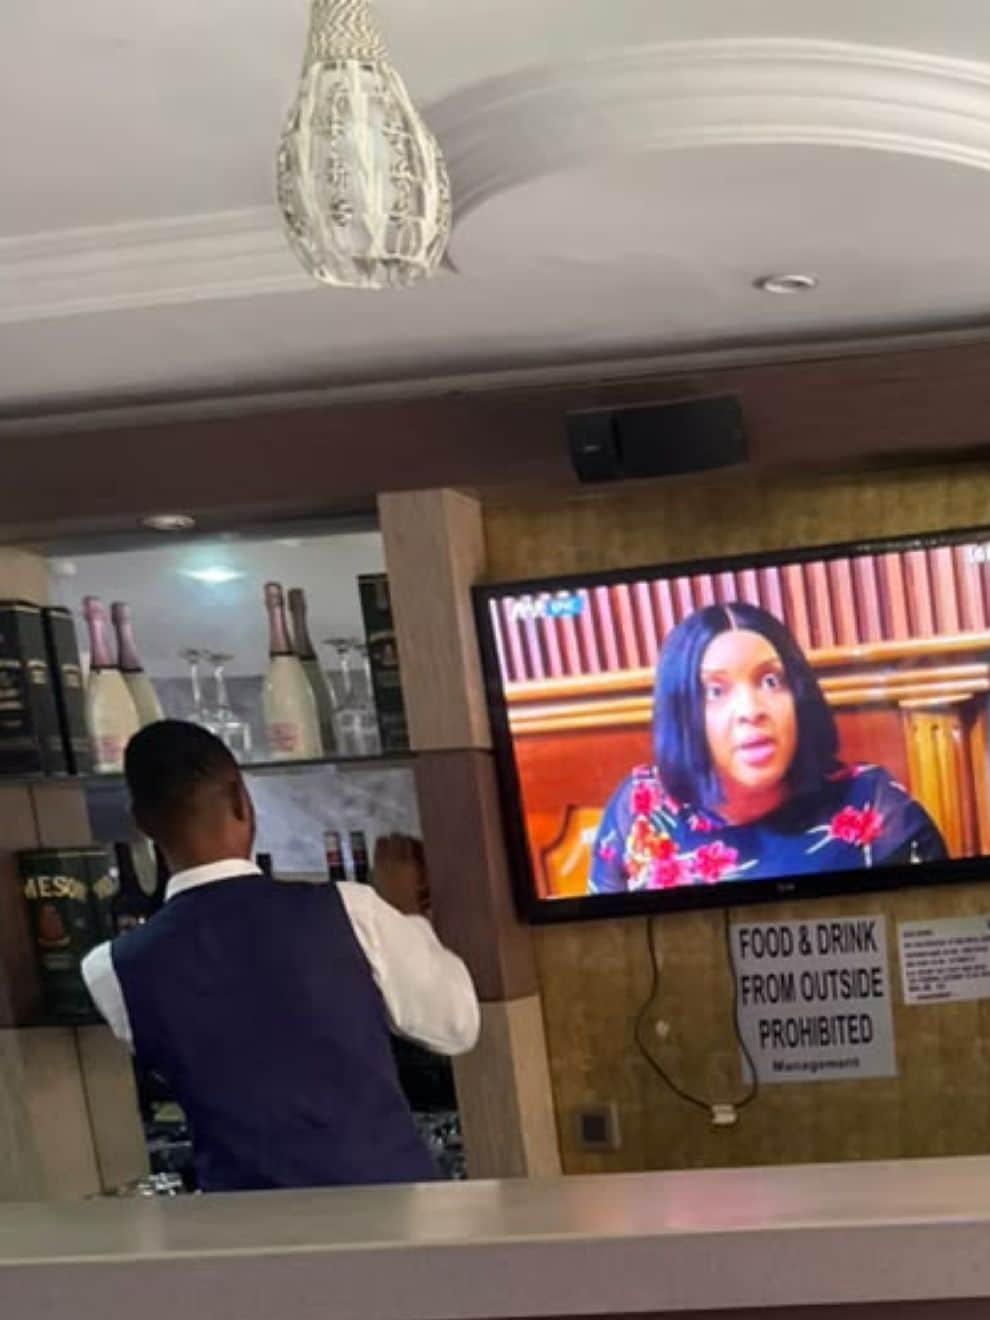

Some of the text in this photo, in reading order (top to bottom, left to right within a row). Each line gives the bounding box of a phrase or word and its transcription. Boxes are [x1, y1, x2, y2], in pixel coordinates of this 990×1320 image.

[739, 920, 877, 960] FOOD & DRINK
[740, 967, 884, 1005] FROM OUTSIDE
[758, 1013, 873, 1048] PROHIBITED
[773, 1058, 860, 1073] Management
